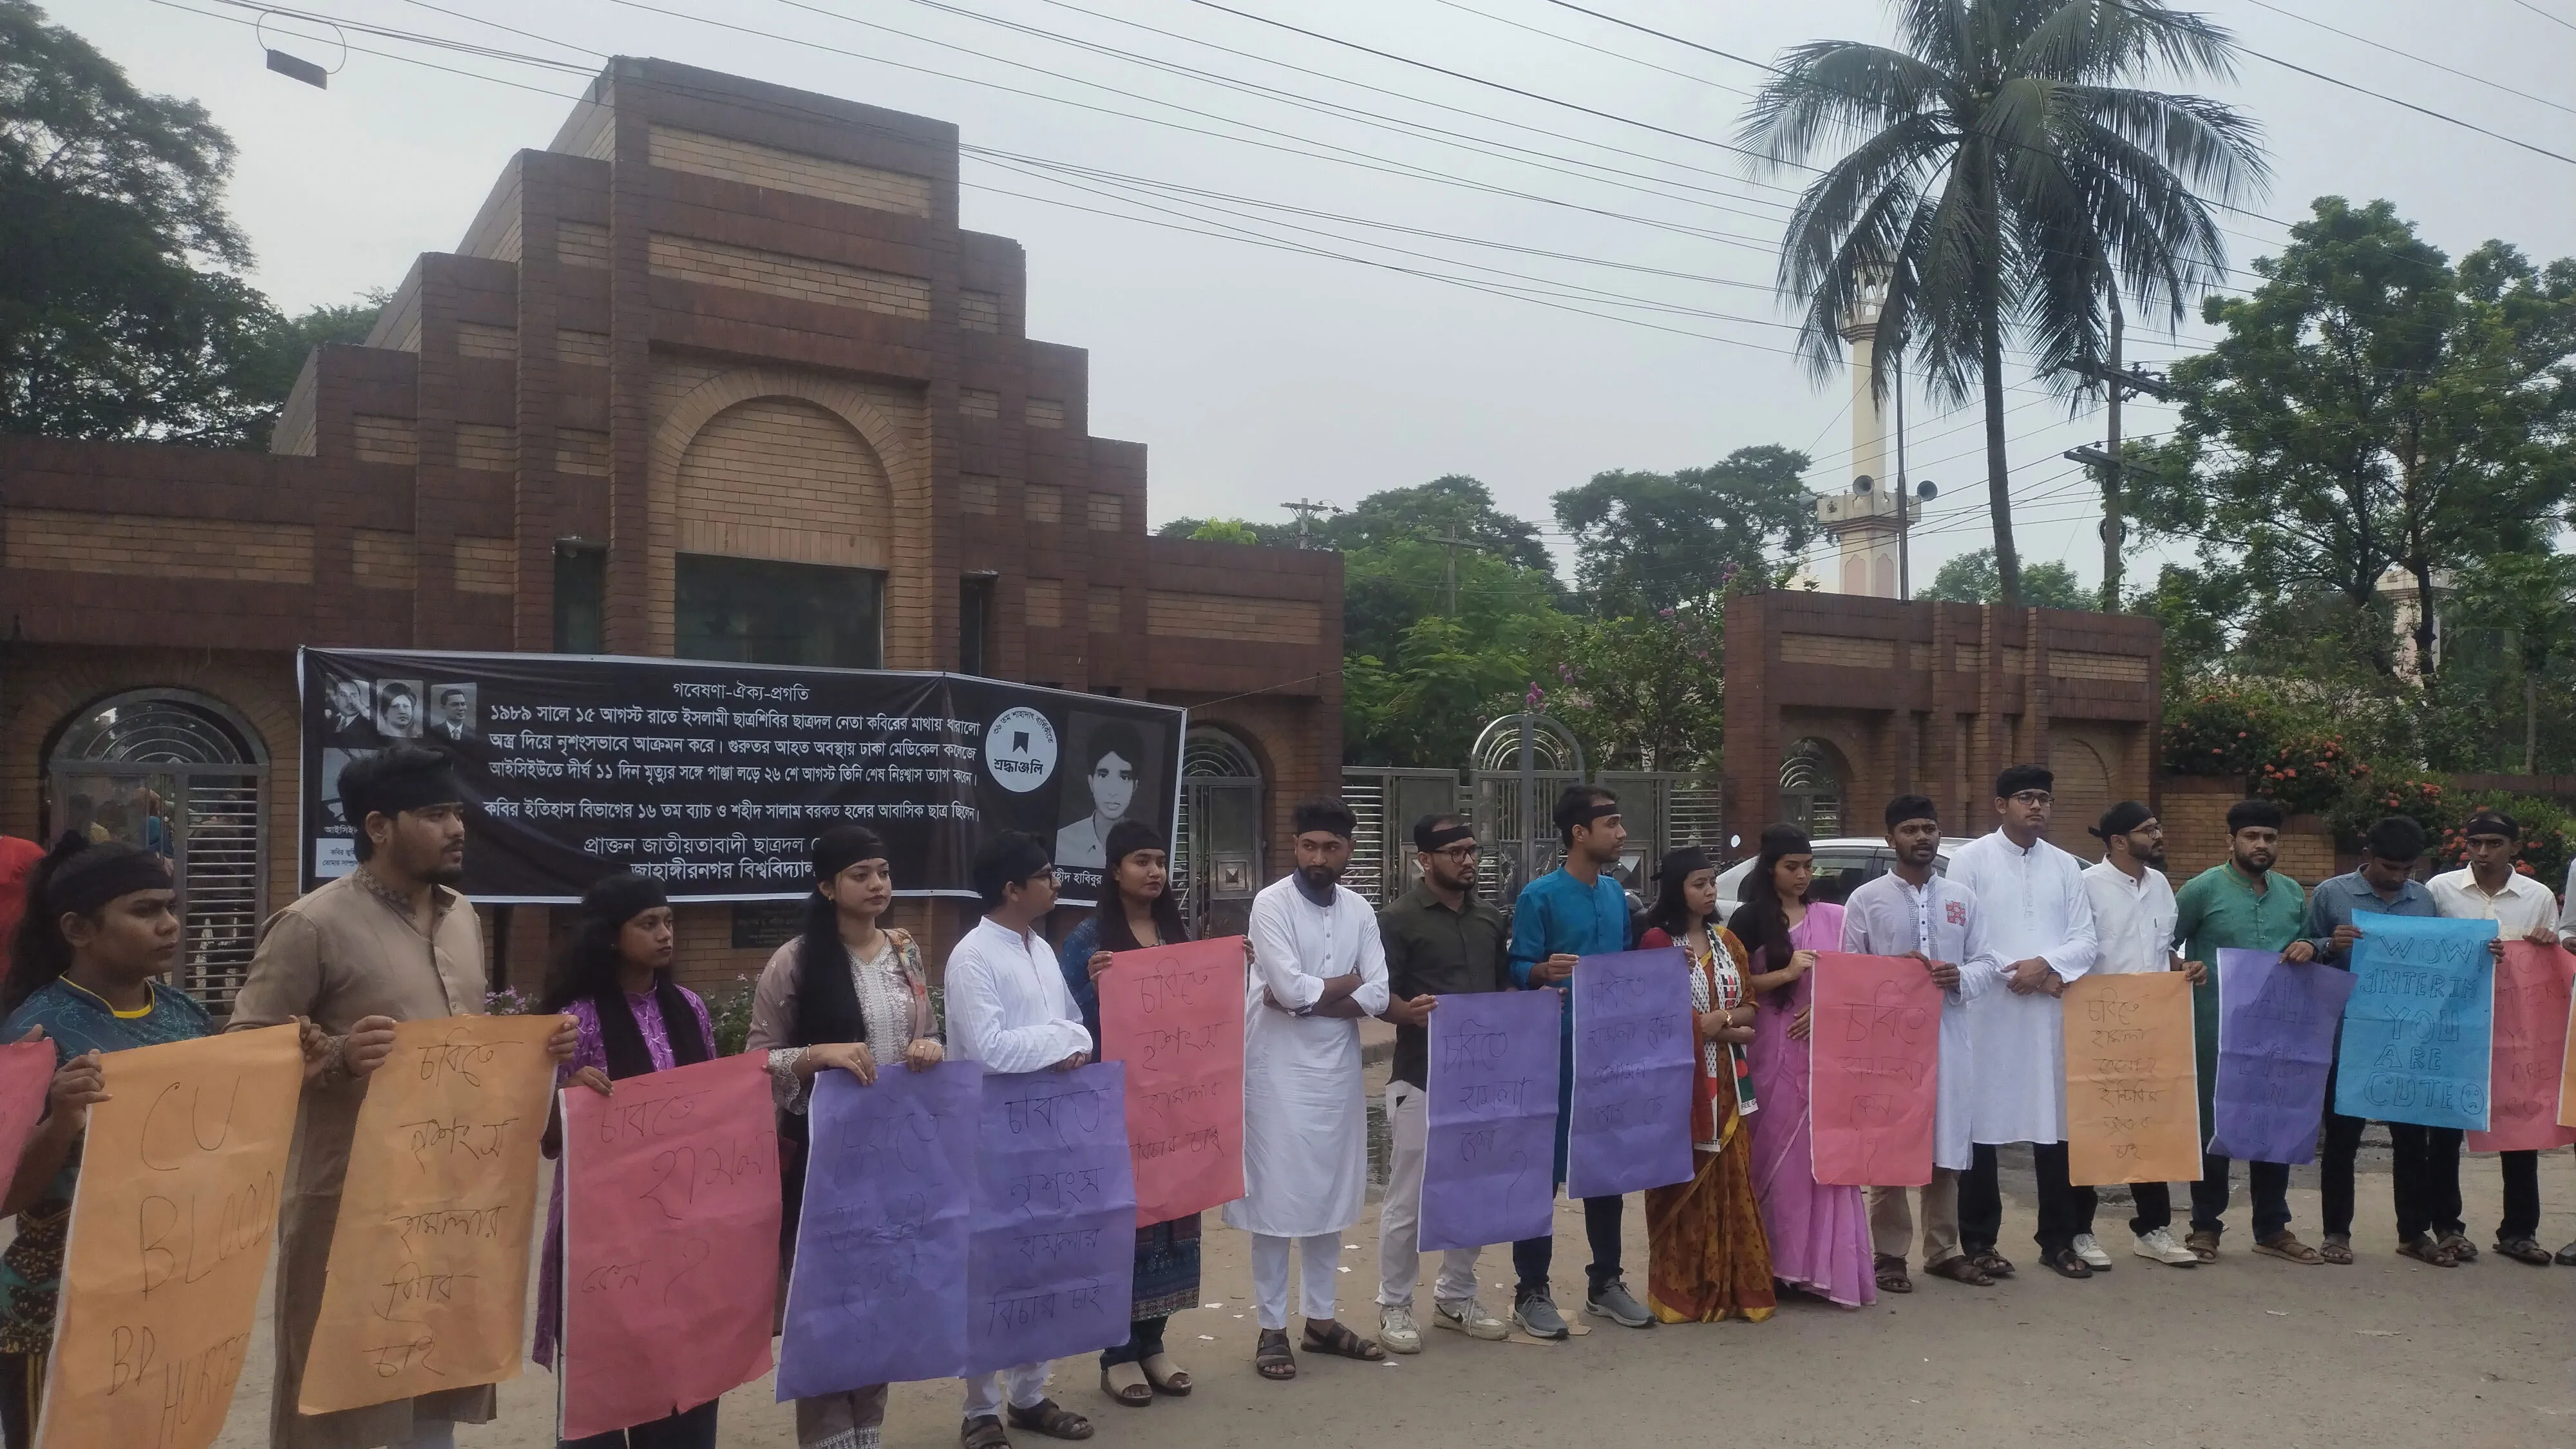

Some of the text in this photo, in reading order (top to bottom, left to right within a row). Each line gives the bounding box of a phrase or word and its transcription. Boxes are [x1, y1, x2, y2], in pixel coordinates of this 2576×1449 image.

[491, 705, 532, 721] ১৯৮৯
[536, 706, 571, 723] সালে
[576, 707, 594, 723] ১৫
[599, 704, 644, 724] আগস্ট
[647, 710, 679, 725] রাতে
[681, 706, 730, 727] ইসলামী
[733, 708, 789, 729] ছাত্রশিবির
[792, 714, 832, 730] ছাত্রদল
[836, 715, 863, 731] নেতা
[867, 712, 909, 732] কবিরের
[947, 718, 981, 737] ধারালো
[993, 723, 1003, 735] ৩৬
[999, 713, 1012, 723] তম
[489, 733, 516, 750] অস্ত্র
[556, 734, 630, 757] নৃশংসভাবে
[632, 737, 685, 753] আক্রমন
[728, 739, 772, 755] গুরুতর
[774, 741, 810, 757] আহত
[859, 742, 886, 758] ঢাকা
[888, 738, 940, 757] মেডিকেল
[943, 743, 978, 762] কলেজে
[488, 757, 565, 779] আইসিইউতে
[566, 757, 594, 779] দীর্ঘ
[596, 764, 613, 780] ১১
[617, 759, 642, 779] দিন
[644, 764, 676, 786] মৃত্যুর
[679, 765, 705, 781] সঙ্গে
[707, 766, 734, 782] পাঞ্জা
[764, 767, 781, 782] ২৬
[784, 766, 801, 782] শে
[802, 763, 837, 783] আগস্ট
[838, 764, 864, 782] তিনি
[865, 766, 886, 783] শেষ
[888, 764, 923, 784] নিঃশ্বাস
[925, 768, 951, 784] ত্যাগ
[994, 758, 1044, 775] শ্রদ্ধাঞ্জলি
[483, 797, 520, 817] কবির
[524, 797, 576, 820] ইতিহাস
[579, 798, 634, 819] বিভাগের
[638, 804, 657, 819] ১৬
[660, 804, 683, 819] তম
[685, 804, 713, 820] ব্যাচ
[716, 806, 727, 818] ও
[730, 799, 763, 820] শহীদ
[764, 804, 802, 820] সালাম
[804, 804, 842, 819] বরকত
[844, 804, 875, 820] হলের
[878, 800, 925, 820] আবাসিক
[927, 804, 949, 820] ছাত্র
[583, 837, 637, 855] প্রাক্তন
[752, 837, 805, 855] ছাত্রদল
[629, 857, 735, 882] জাহাঙ্গীরনগর
[1072, 870, 1103, 887] হাবিবুর
[2384, 1005, 2459, 1045] YOU
[2374, 1044, 2441, 1070] ARE
[2364, 1071, 2452, 1109] CUTE
[141, 1075, 241, 1171] CU
[140, 1171, 275, 1302] BLOOD
[107, 1325, 156, 1396] BD
